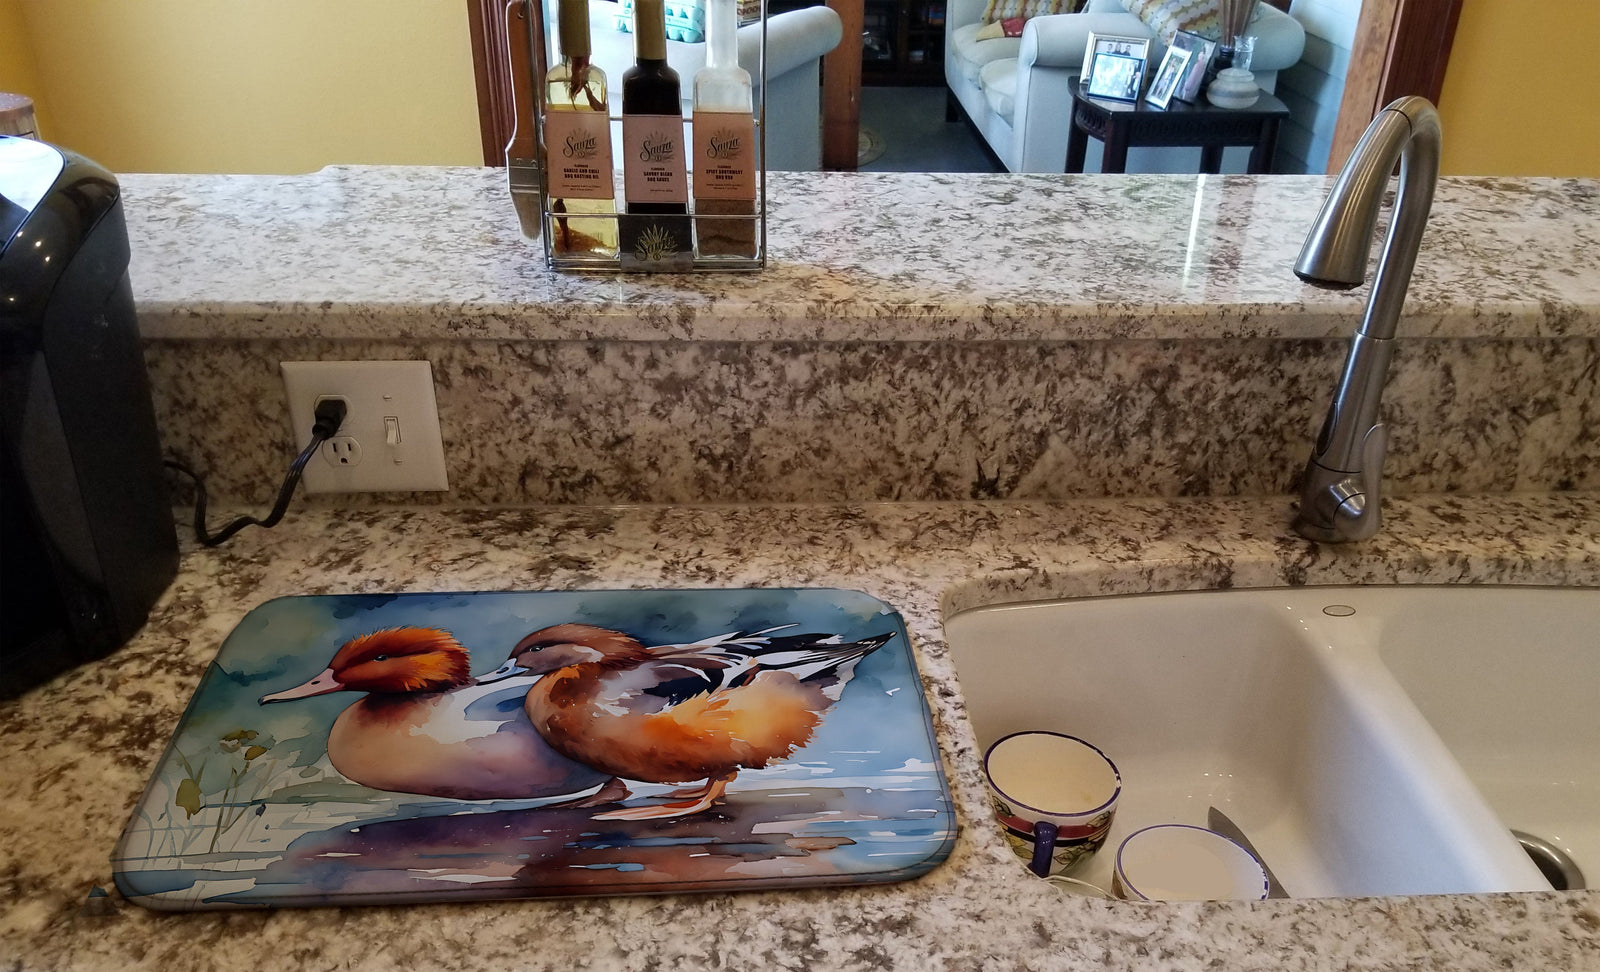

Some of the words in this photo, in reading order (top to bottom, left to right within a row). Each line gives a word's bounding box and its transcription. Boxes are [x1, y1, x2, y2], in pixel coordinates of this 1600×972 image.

[563, 136, 597, 158] Sauza
[640, 140, 673, 161] Sauza
[707, 137, 741, 158] Sauza
